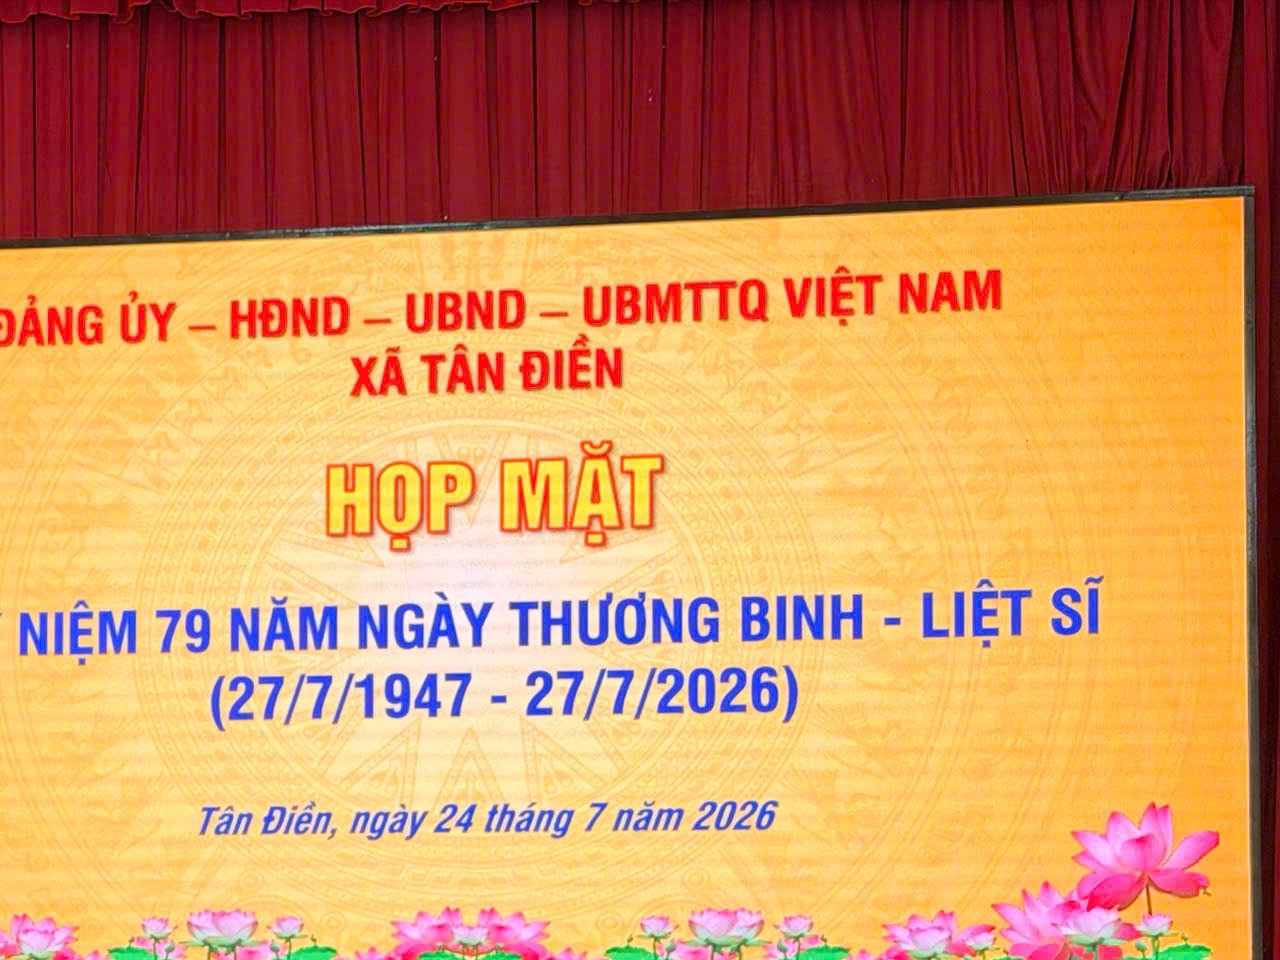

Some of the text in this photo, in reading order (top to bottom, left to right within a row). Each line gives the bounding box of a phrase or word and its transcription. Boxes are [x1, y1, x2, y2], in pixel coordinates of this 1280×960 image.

[120, 290, 176, 344] ỦY
[230, 296, 350, 339] HĐND
[406, 289, 526, 333] UBND
[583, 278, 768, 327] UBMTTQ
[783, 265, 883, 326] VIỆT
[899, 269, 1002, 314] NAM
[351, 333, 623, 397] XÃ TÂN ĐIỀN
[328, 440, 665, 551] HỌP MẶT
[19, 600, 137, 665] NIỆM
[155, 607, 211, 653] 79
[229, 597, 339, 652] NĂM
[357, 591, 493, 650] NGÀY
[507, 591, 720, 647] THƯƠNG
[740, 593, 863, 642] BINH
[883, 616, 901, 625] -
[921, 578, 1032, 647] LIỆT
[1050, 575, 1105, 636] SĨ
[210, 665, 799, 730] (27/7/1947 - 27/7/2026)
[200, 799, 778, 841] Tân Điền, ngày 24 tháng 7 năm 2026
